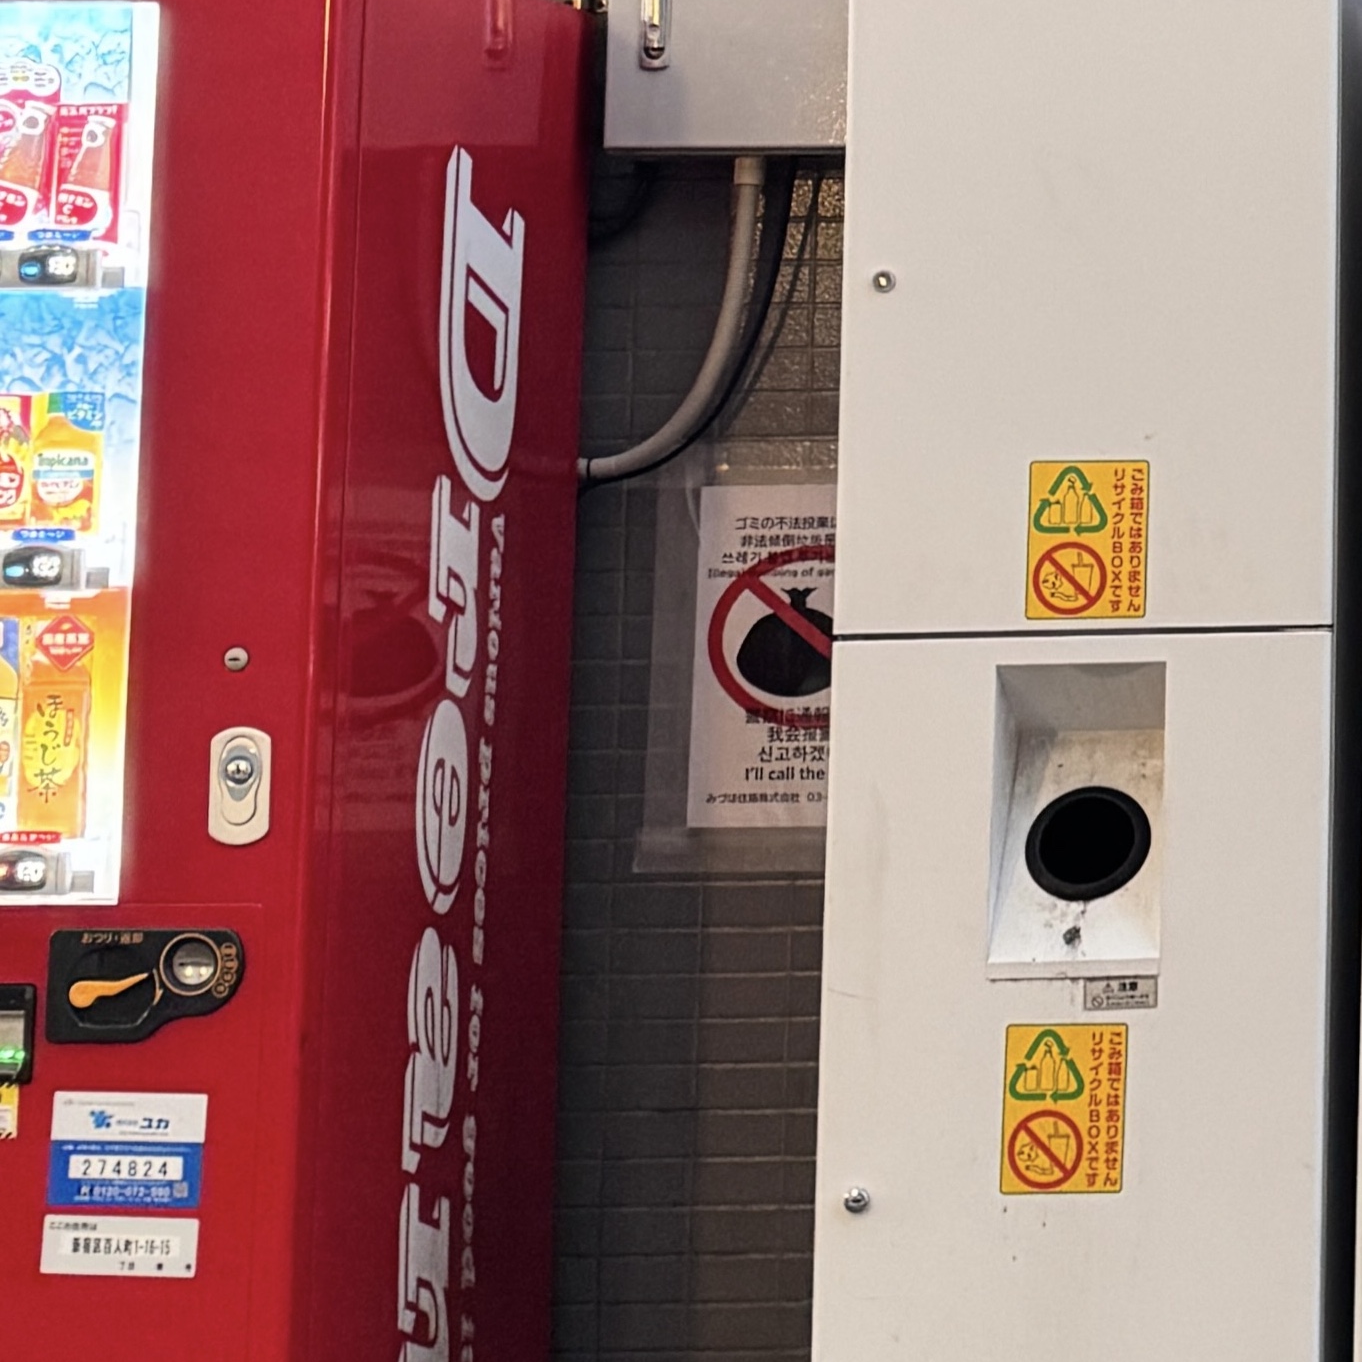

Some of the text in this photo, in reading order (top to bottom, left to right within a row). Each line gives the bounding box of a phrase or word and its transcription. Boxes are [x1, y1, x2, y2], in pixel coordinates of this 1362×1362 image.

[37, 453, 89, 468] Tropicana
[1108, 467, 1126, 613] リサイクルBOXです
[801, 567, 813, 577] of
[27, 693, 65, 804] ほうじ茶
[758, 745, 830, 763] 신고하겠
[768, 767, 794, 780] call
[799, 767, 826, 780] the
[472, 735, 494, 966] prices
[1085, 1031, 1104, 1188] リサイクルBOXです
[140, 1117, 170, 1130] ユカ
[82, 1159, 168, 1178] 274824
[459, 1113, 478, 1290] good
